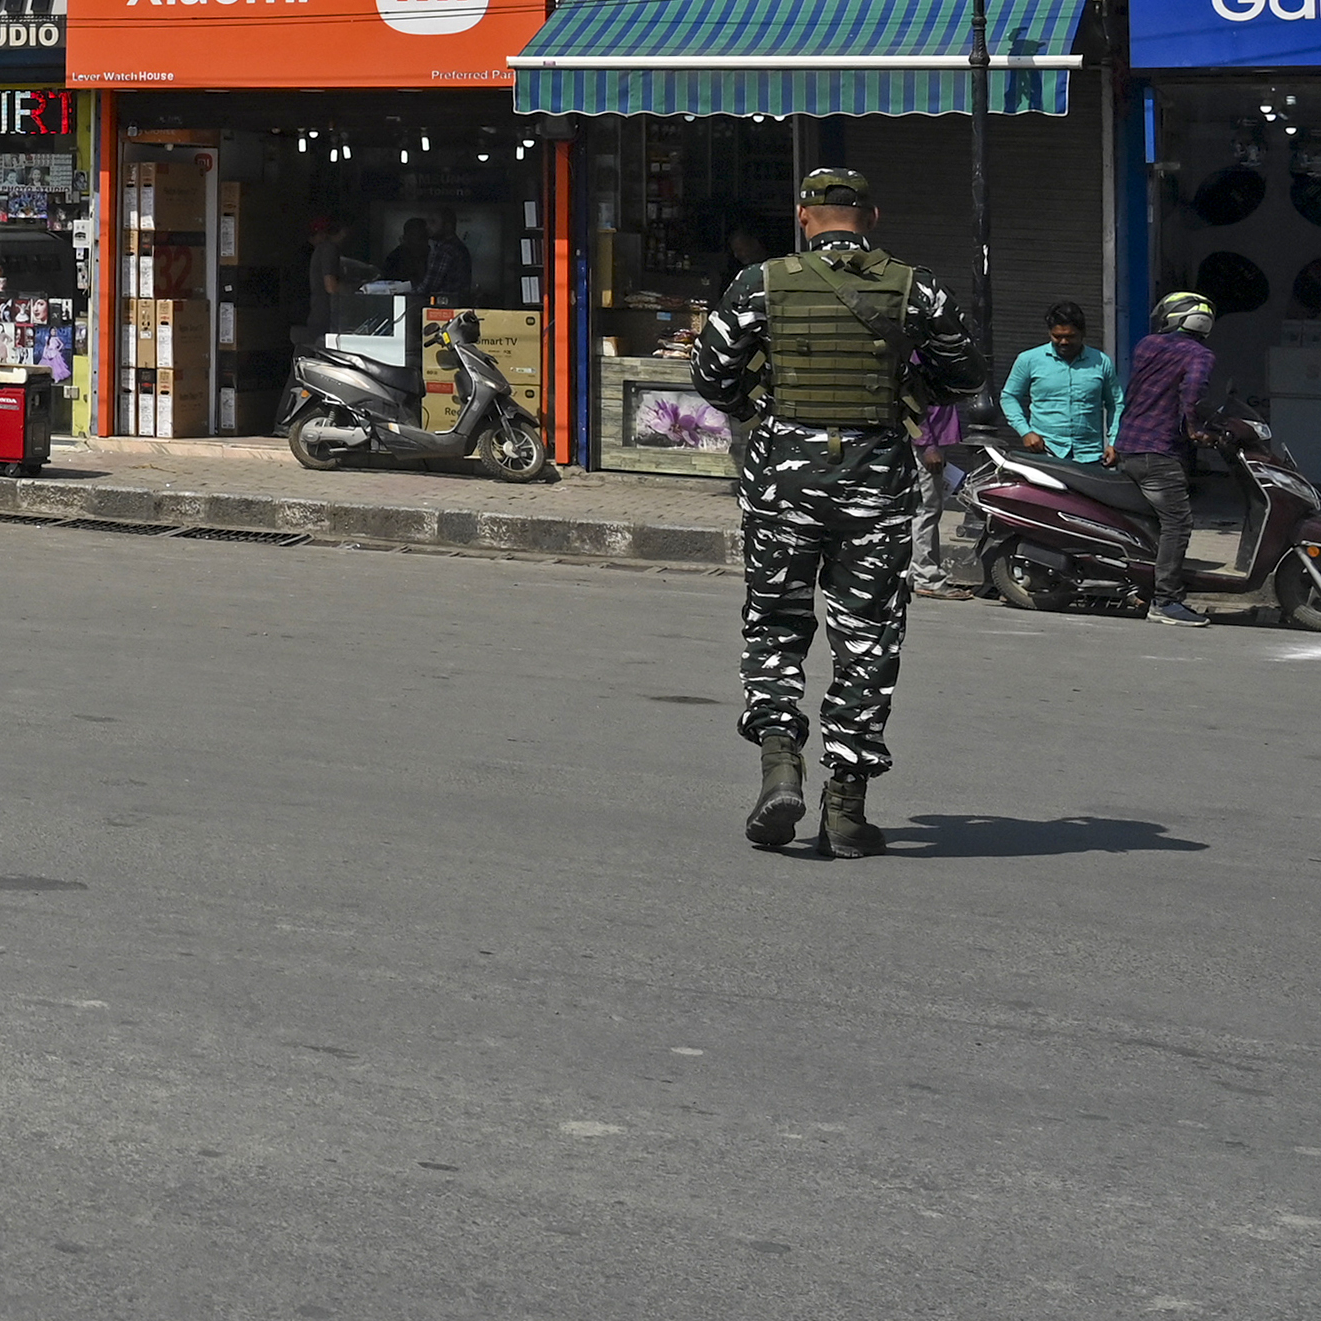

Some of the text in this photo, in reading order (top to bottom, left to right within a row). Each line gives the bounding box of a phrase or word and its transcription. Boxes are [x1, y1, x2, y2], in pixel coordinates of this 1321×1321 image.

[71, 71, 175, 82] Lever Watch House
[431, 69, 515, 80] Preferred Par
[505, 337, 518, 346] TV
